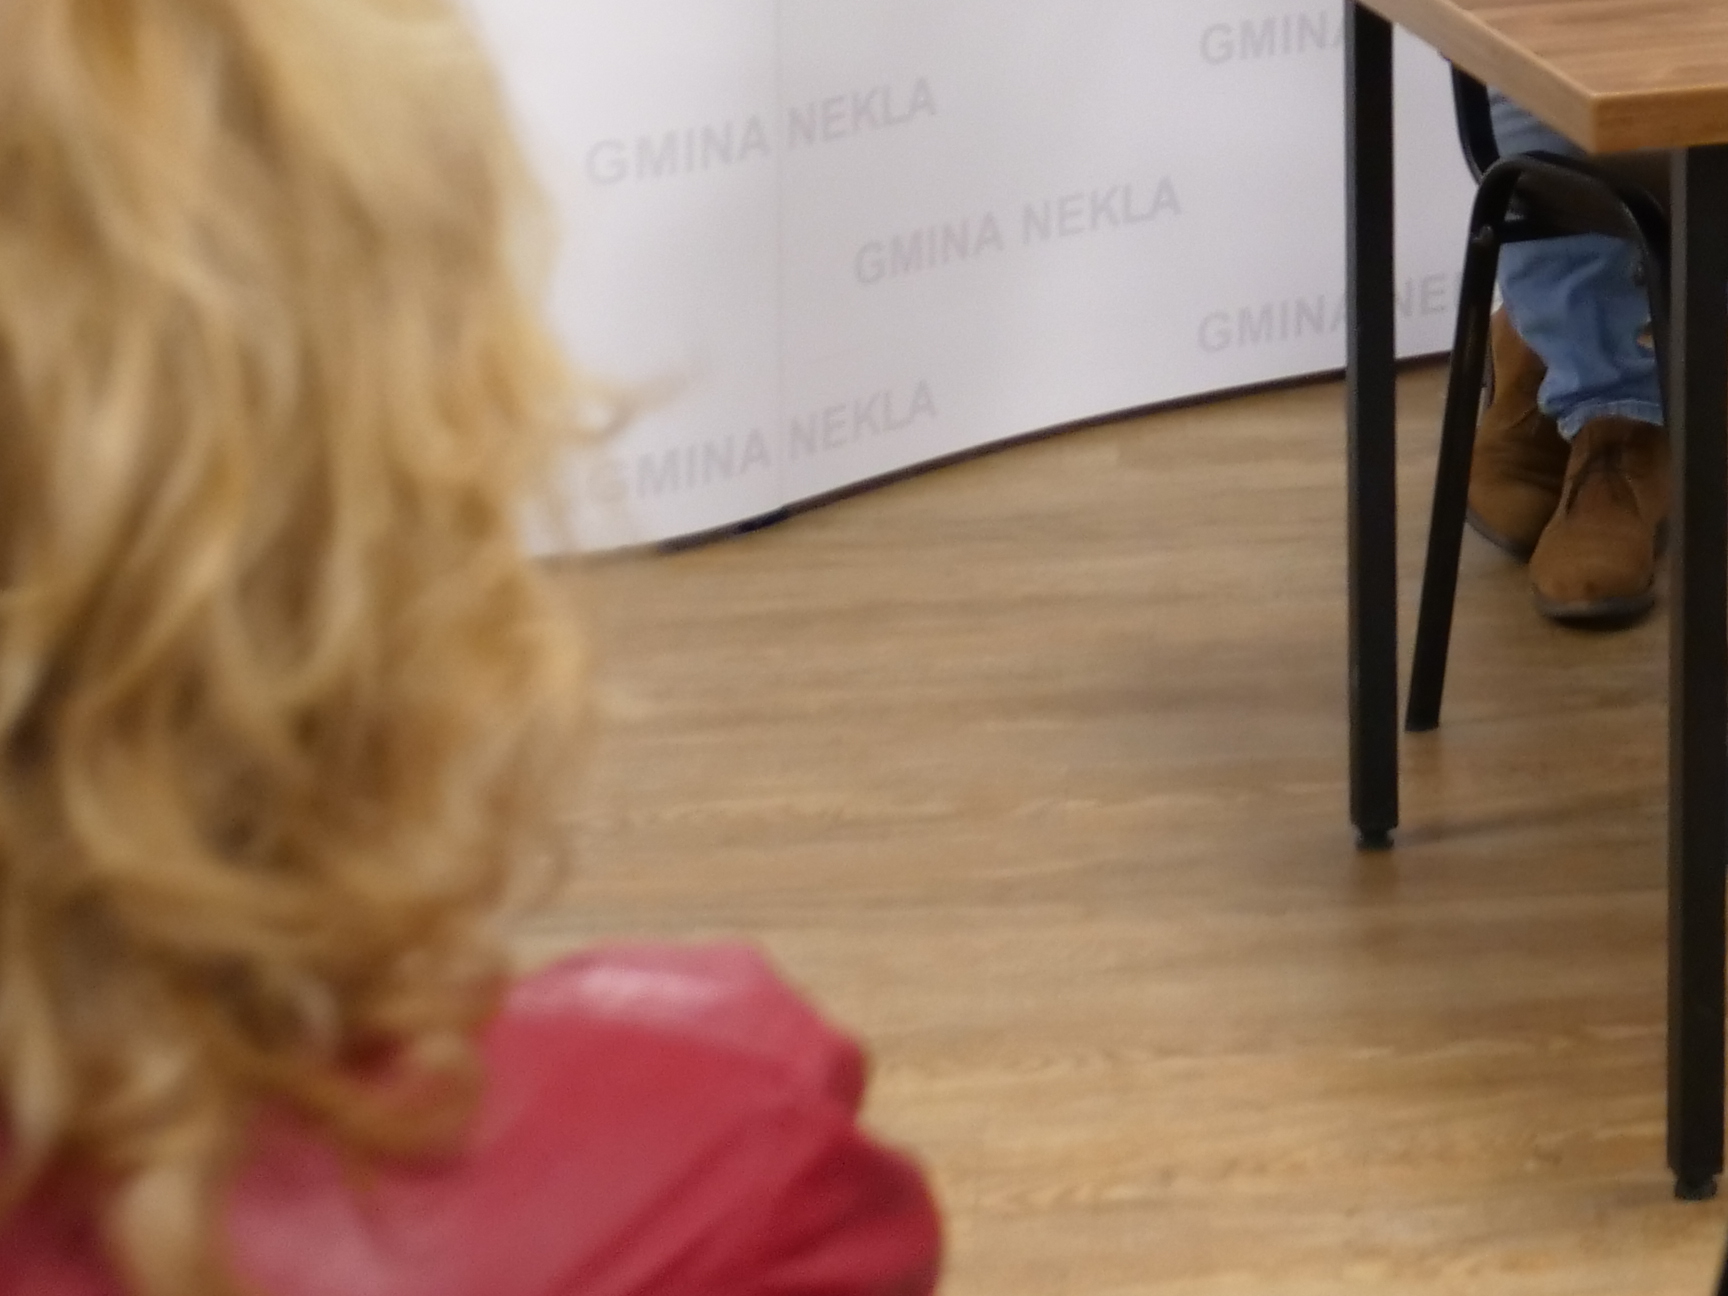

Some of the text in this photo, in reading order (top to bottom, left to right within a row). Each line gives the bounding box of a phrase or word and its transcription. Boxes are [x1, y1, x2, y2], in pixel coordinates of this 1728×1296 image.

[1200, 10, 1342, 66] GMIN
[584, 77, 938, 188] GMINA NEKLA
[854, 175, 1183, 286] GMINA NEKLA
[788, 379, 939, 461] NEKLA
